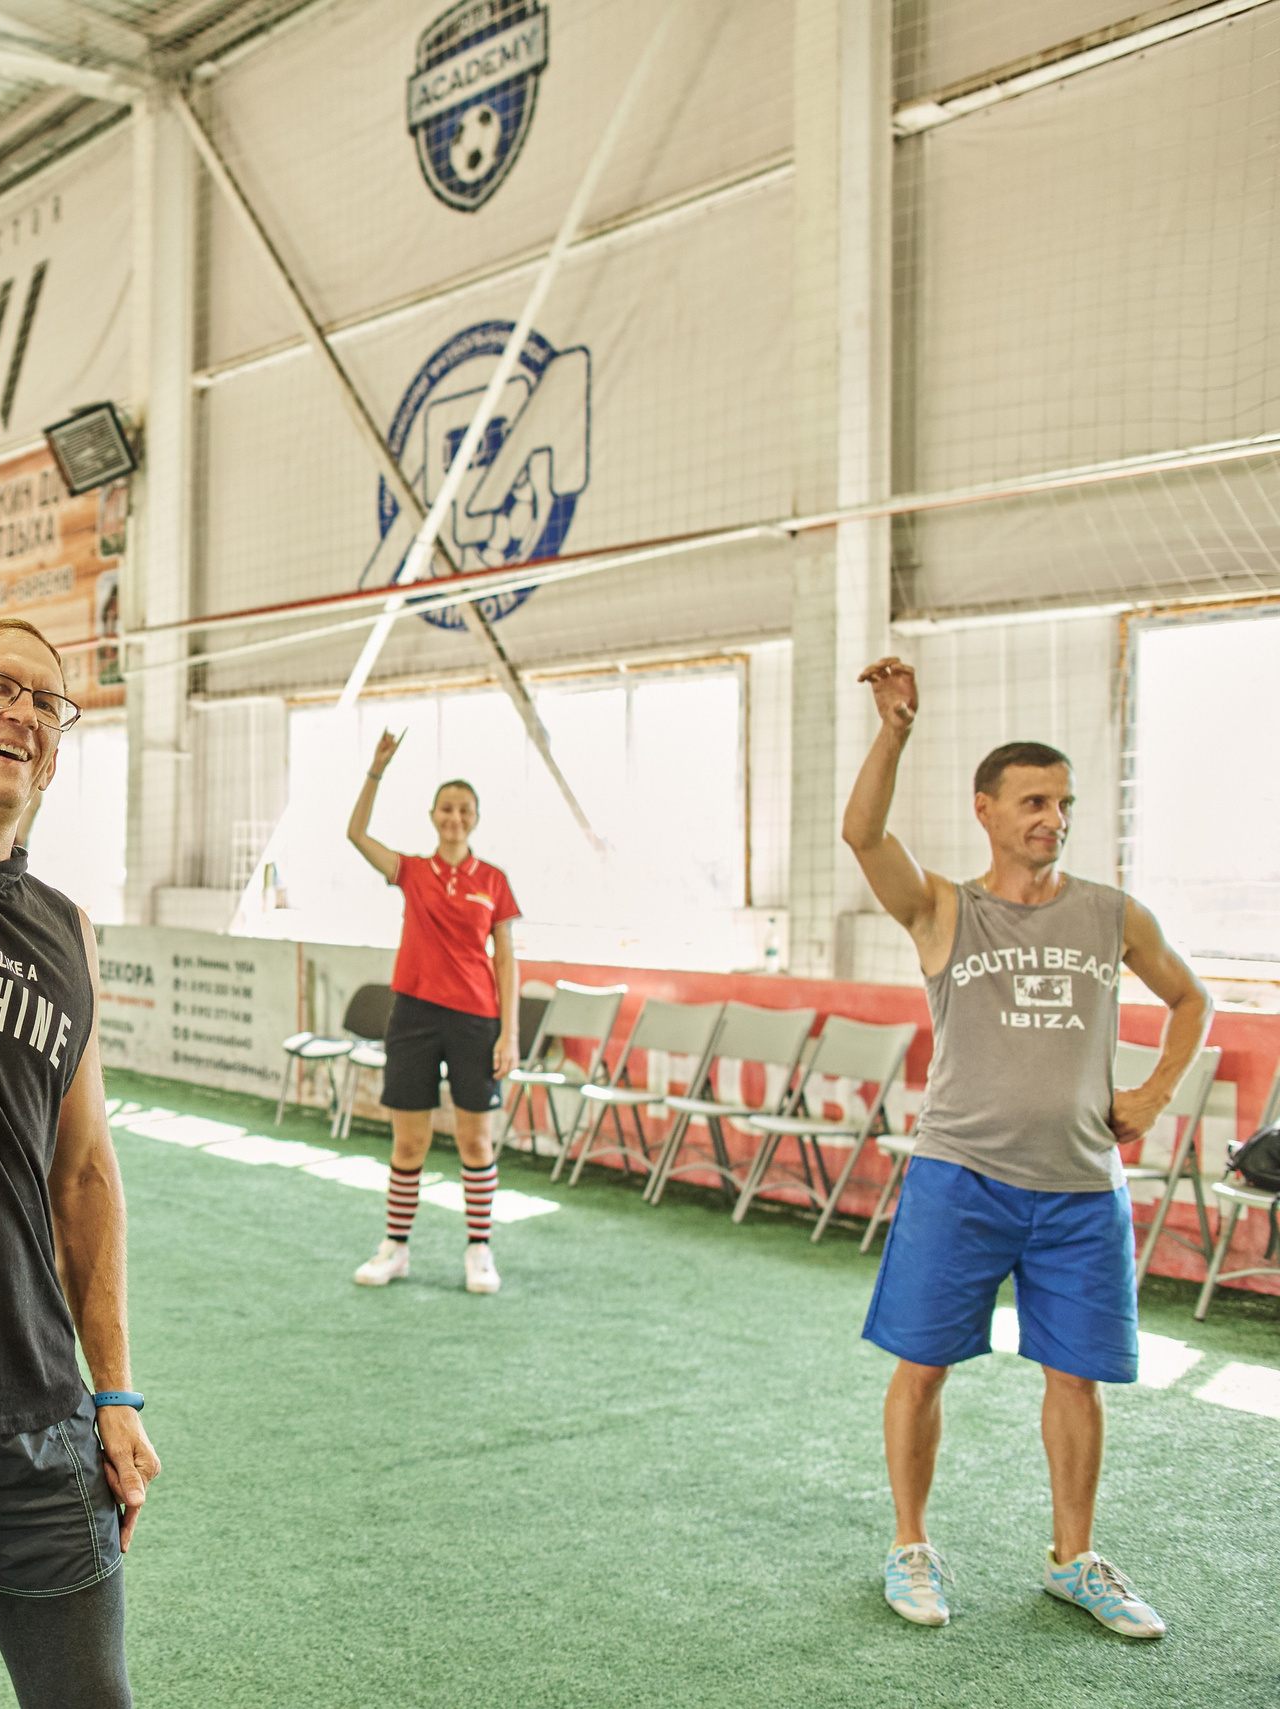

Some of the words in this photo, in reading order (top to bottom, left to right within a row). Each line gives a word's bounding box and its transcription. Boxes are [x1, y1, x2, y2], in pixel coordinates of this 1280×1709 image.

[418, 26, 540, 106] ACADEMY
[0, 950, 24, 978] LIKE
[27, 964, 38, 981] A
[951, 946, 1038, 987] SOUTH
[1001, 1010, 1086, 1031] IBIZA
